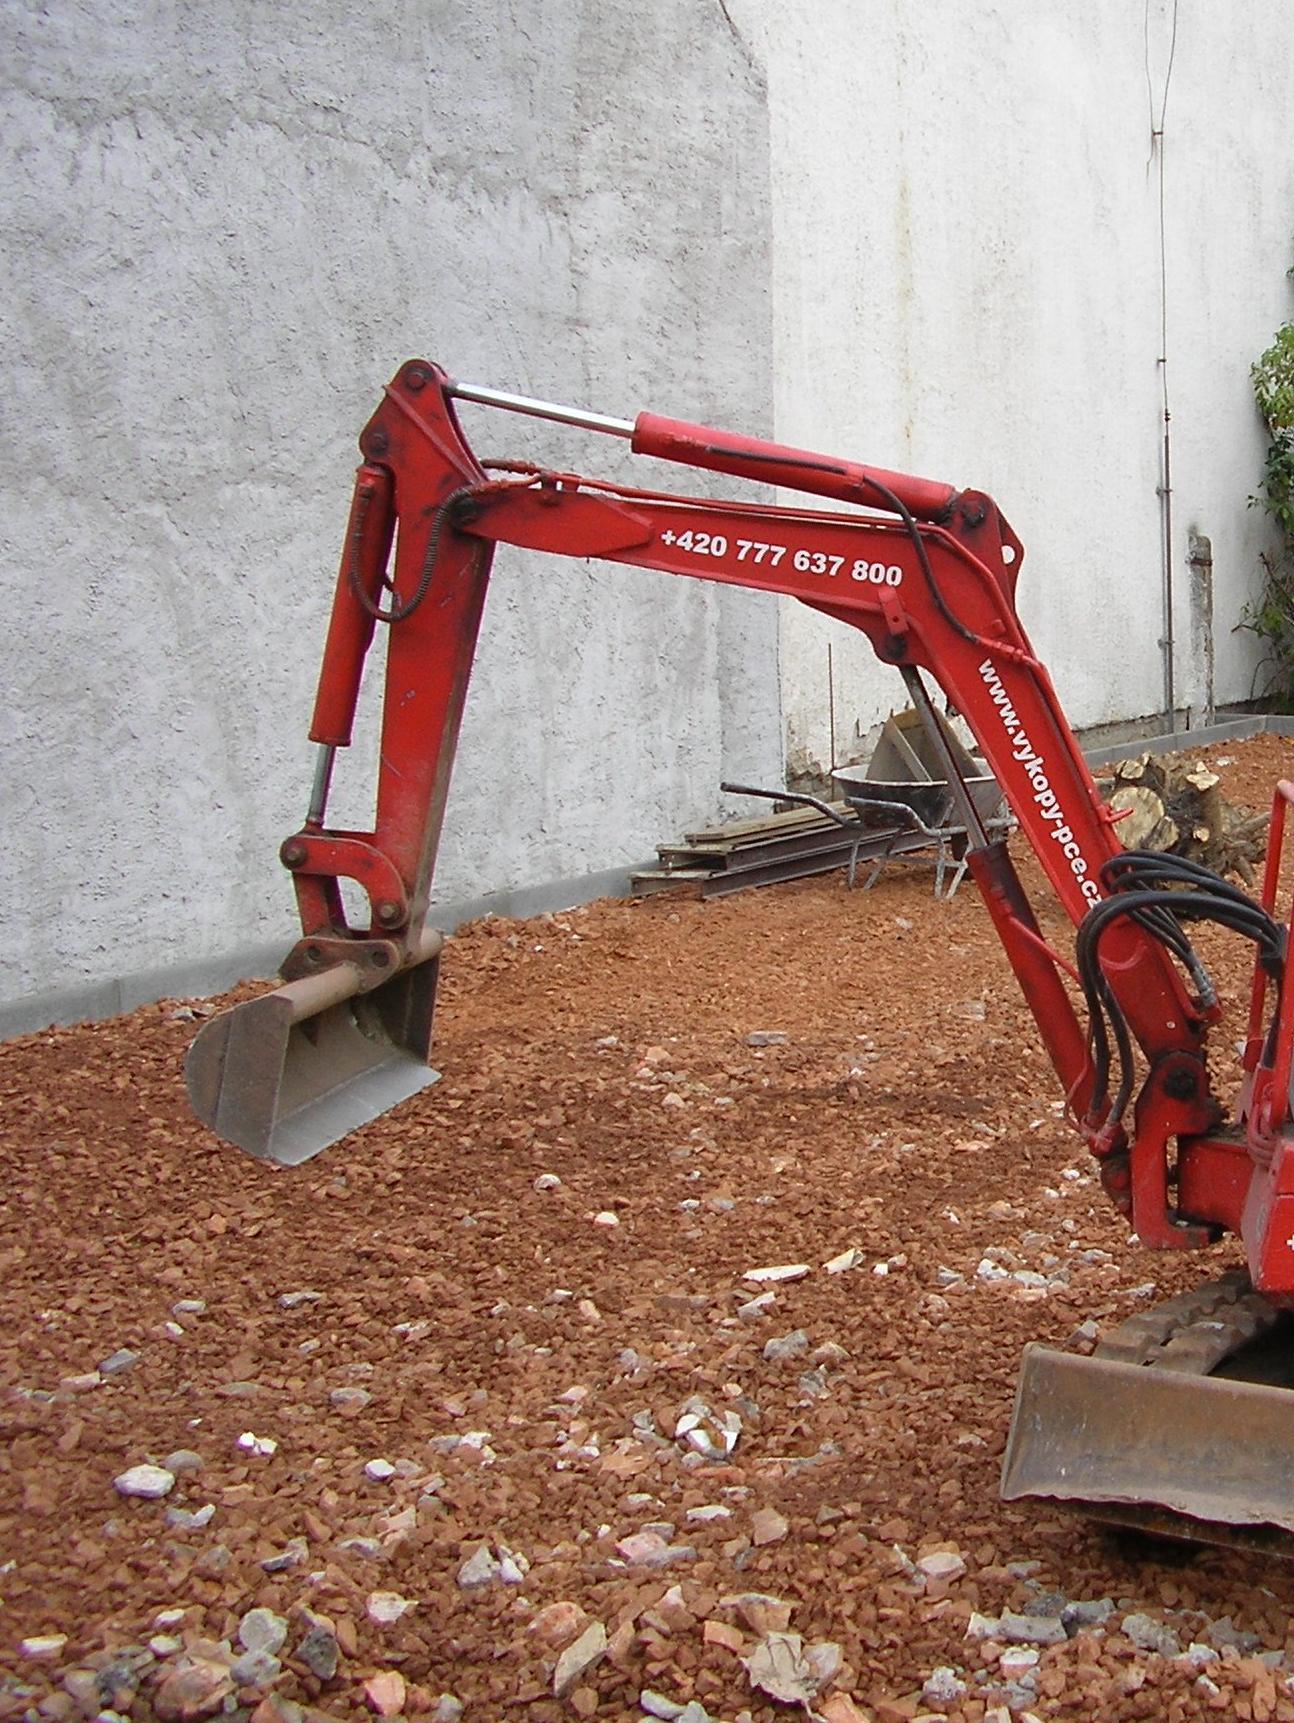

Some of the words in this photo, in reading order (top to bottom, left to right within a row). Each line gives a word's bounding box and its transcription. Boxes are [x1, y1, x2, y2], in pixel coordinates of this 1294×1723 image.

[661, 530, 727, 556] +420
[736, 540, 786, 566] 777
[793, 550, 845, 576] 637
[851, 560, 903, 586] 800
